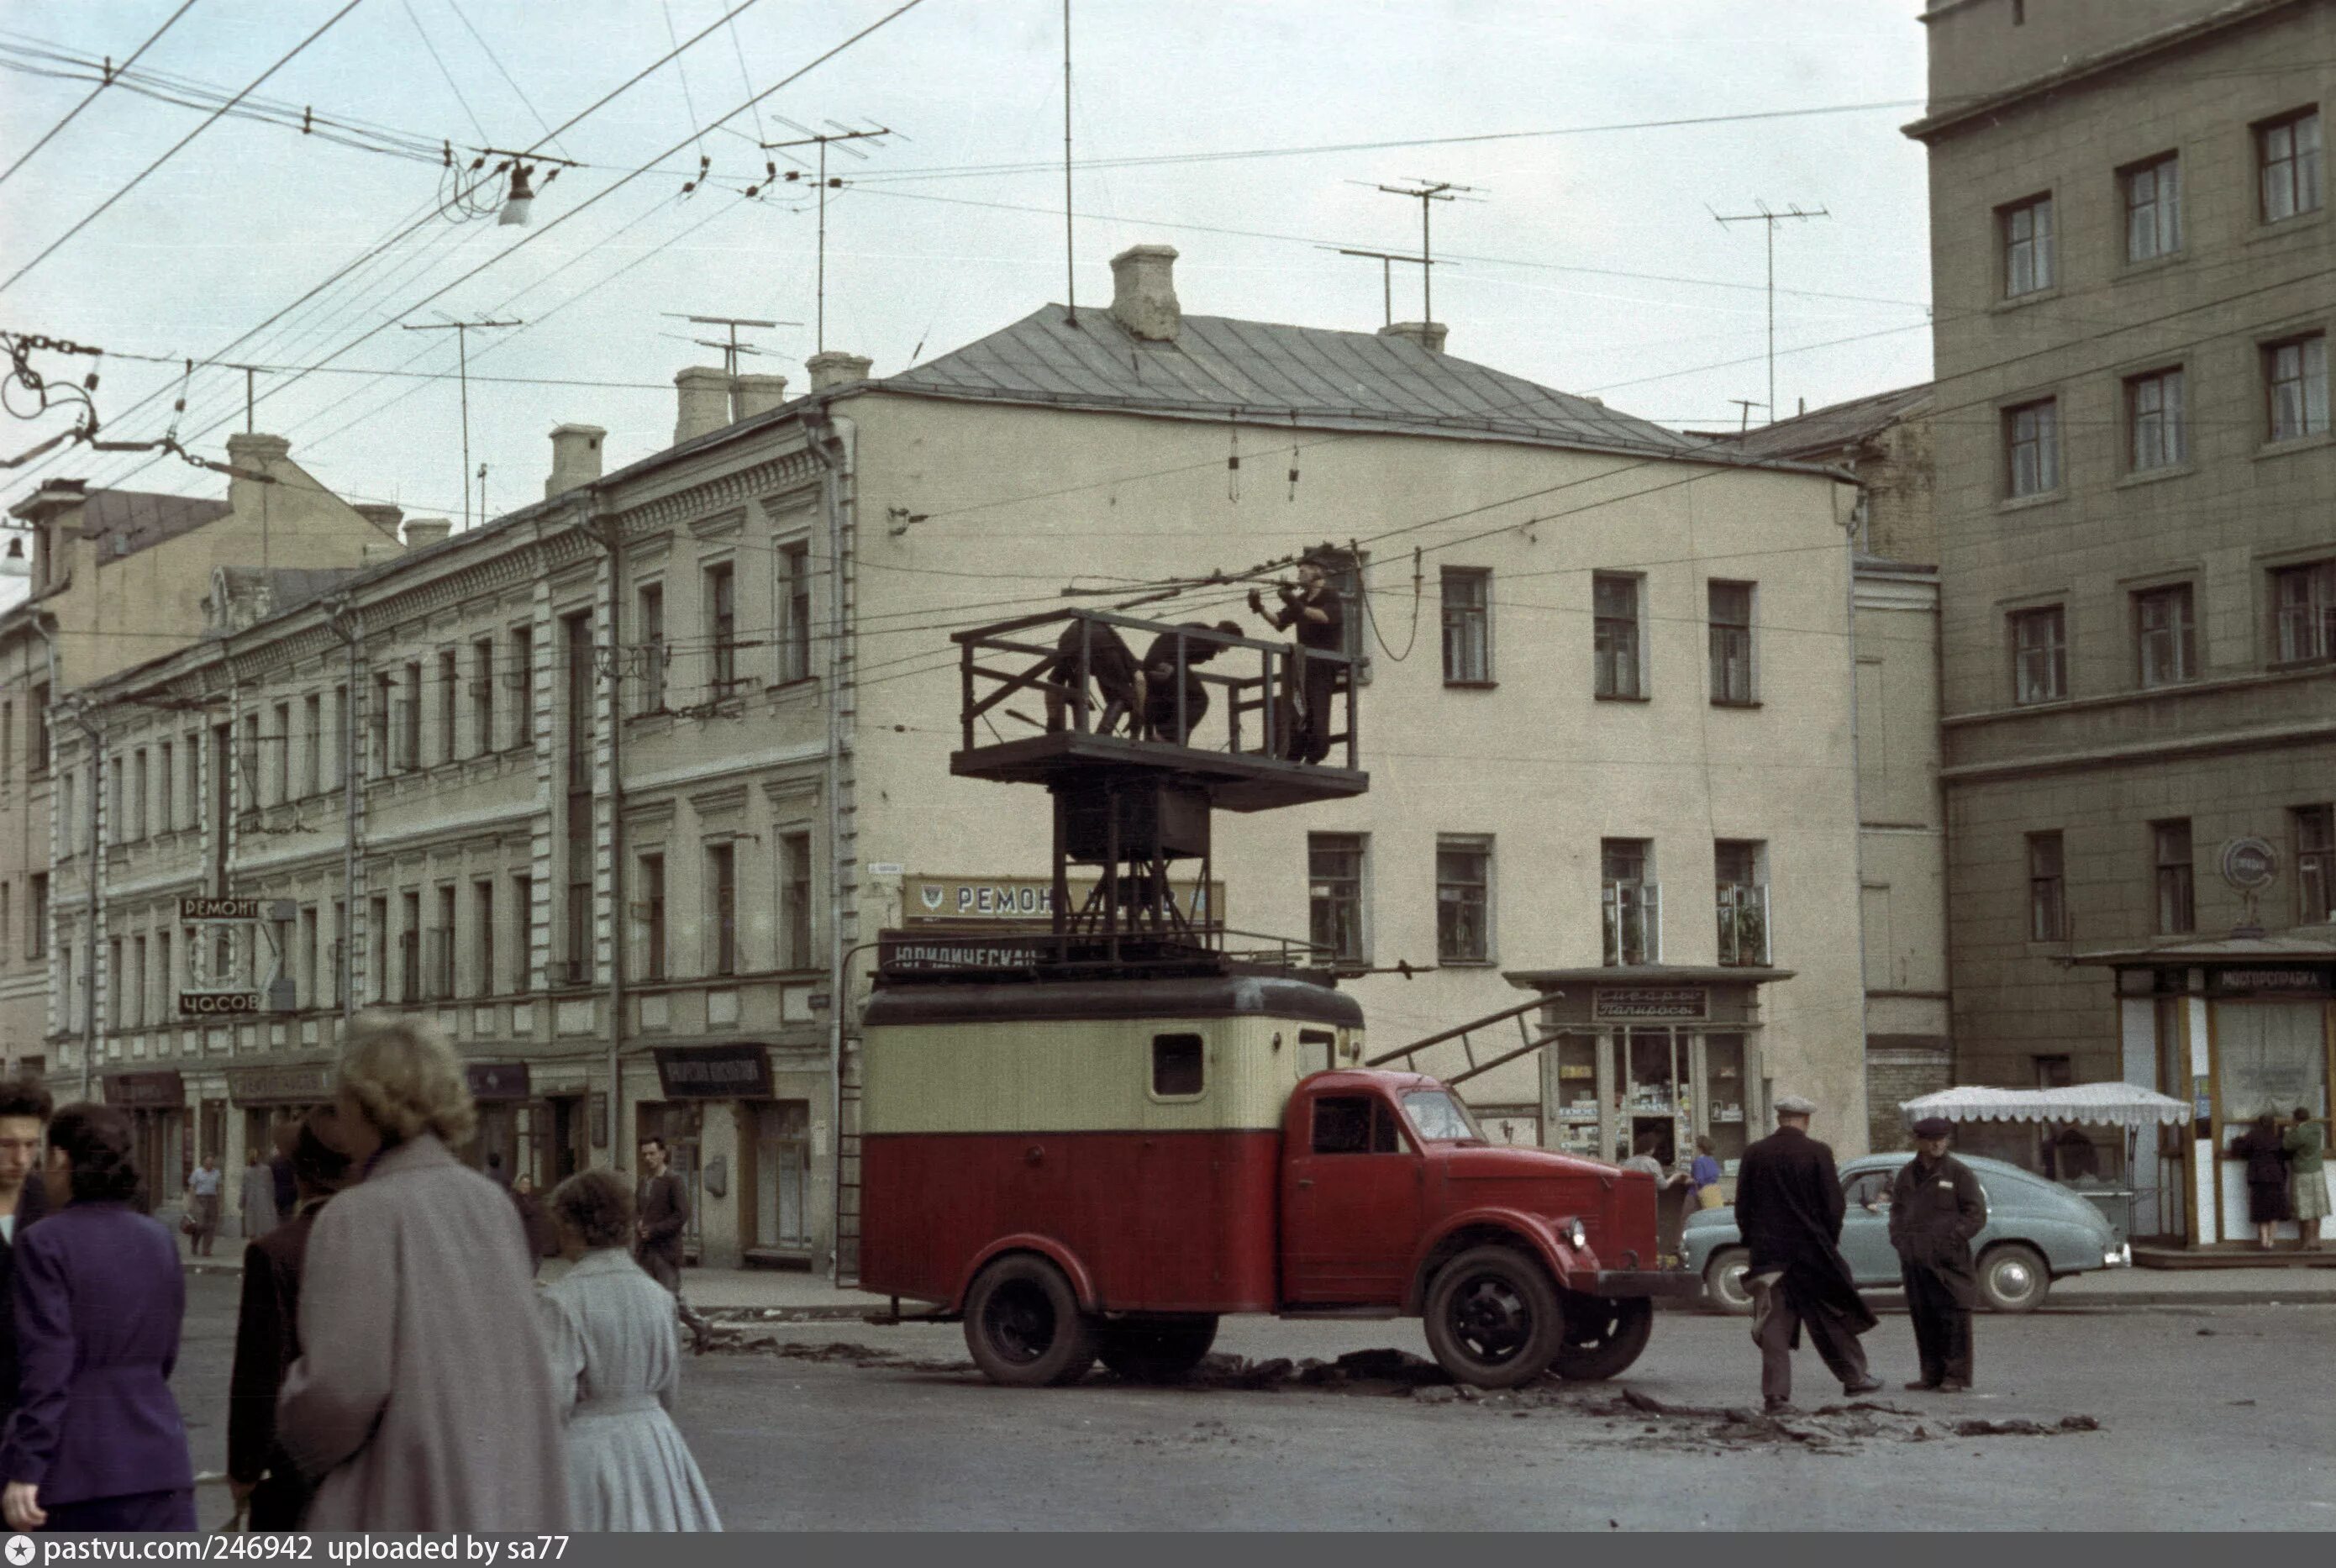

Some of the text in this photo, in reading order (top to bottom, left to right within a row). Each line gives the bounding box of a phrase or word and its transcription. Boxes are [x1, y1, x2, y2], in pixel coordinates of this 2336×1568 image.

[185, 900, 257, 916] РЕМОНТ
[957, 887, 1055, 913] РЕМОН
[1598, 1003, 1696, 1016] Папиросы
